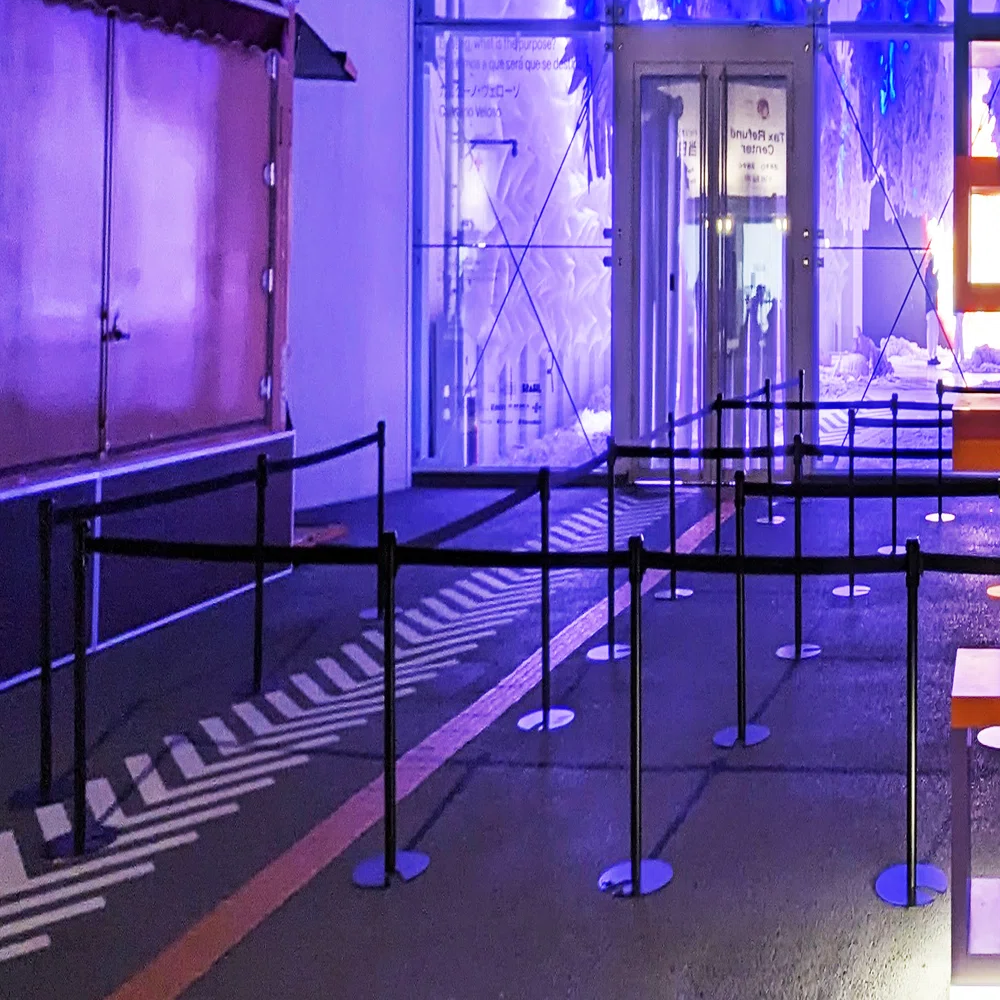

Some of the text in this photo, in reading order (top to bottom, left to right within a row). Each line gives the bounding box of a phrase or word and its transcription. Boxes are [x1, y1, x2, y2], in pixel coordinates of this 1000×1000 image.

[518, 38, 556, 51] purpose?
[505, 55, 523, 70] será
[525, 60, 540, 72] que
[542, 60, 552, 70] se
